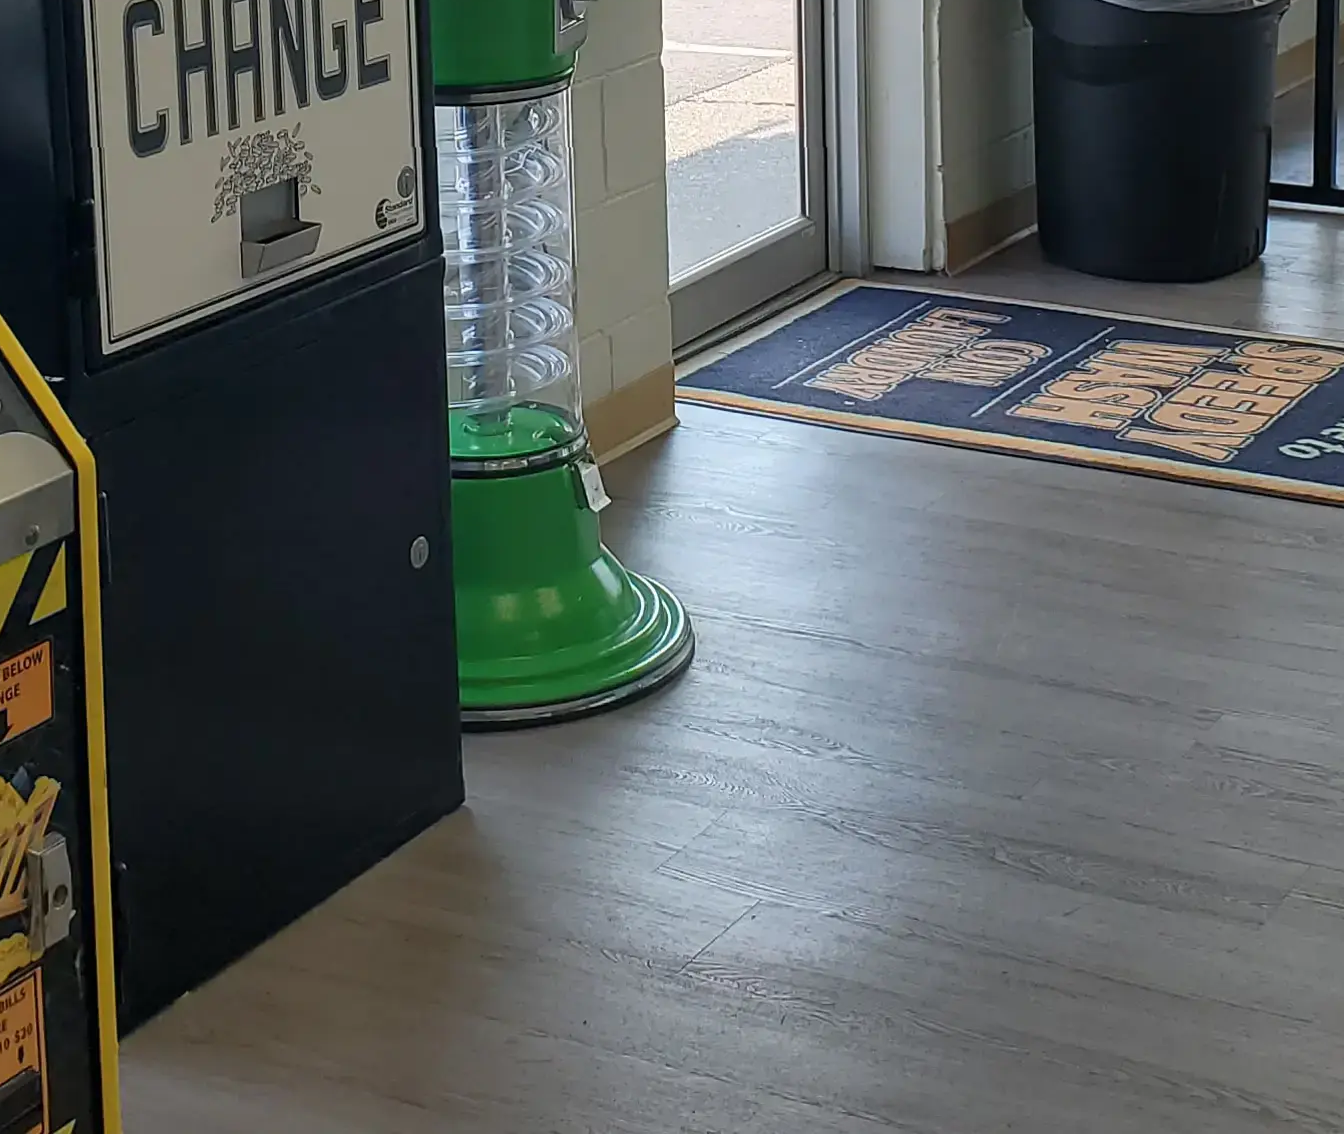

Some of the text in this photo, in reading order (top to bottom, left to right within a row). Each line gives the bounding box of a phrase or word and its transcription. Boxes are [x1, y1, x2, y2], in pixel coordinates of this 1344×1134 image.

[803, 306, 1012, 402] LAUNDRY
[915, 338, 1053, 388] COIN
[1005, 339, 1234, 431] WASH
[2, 649, 43, 682] BELOW
[14, 1022, 33, 1043] $20
